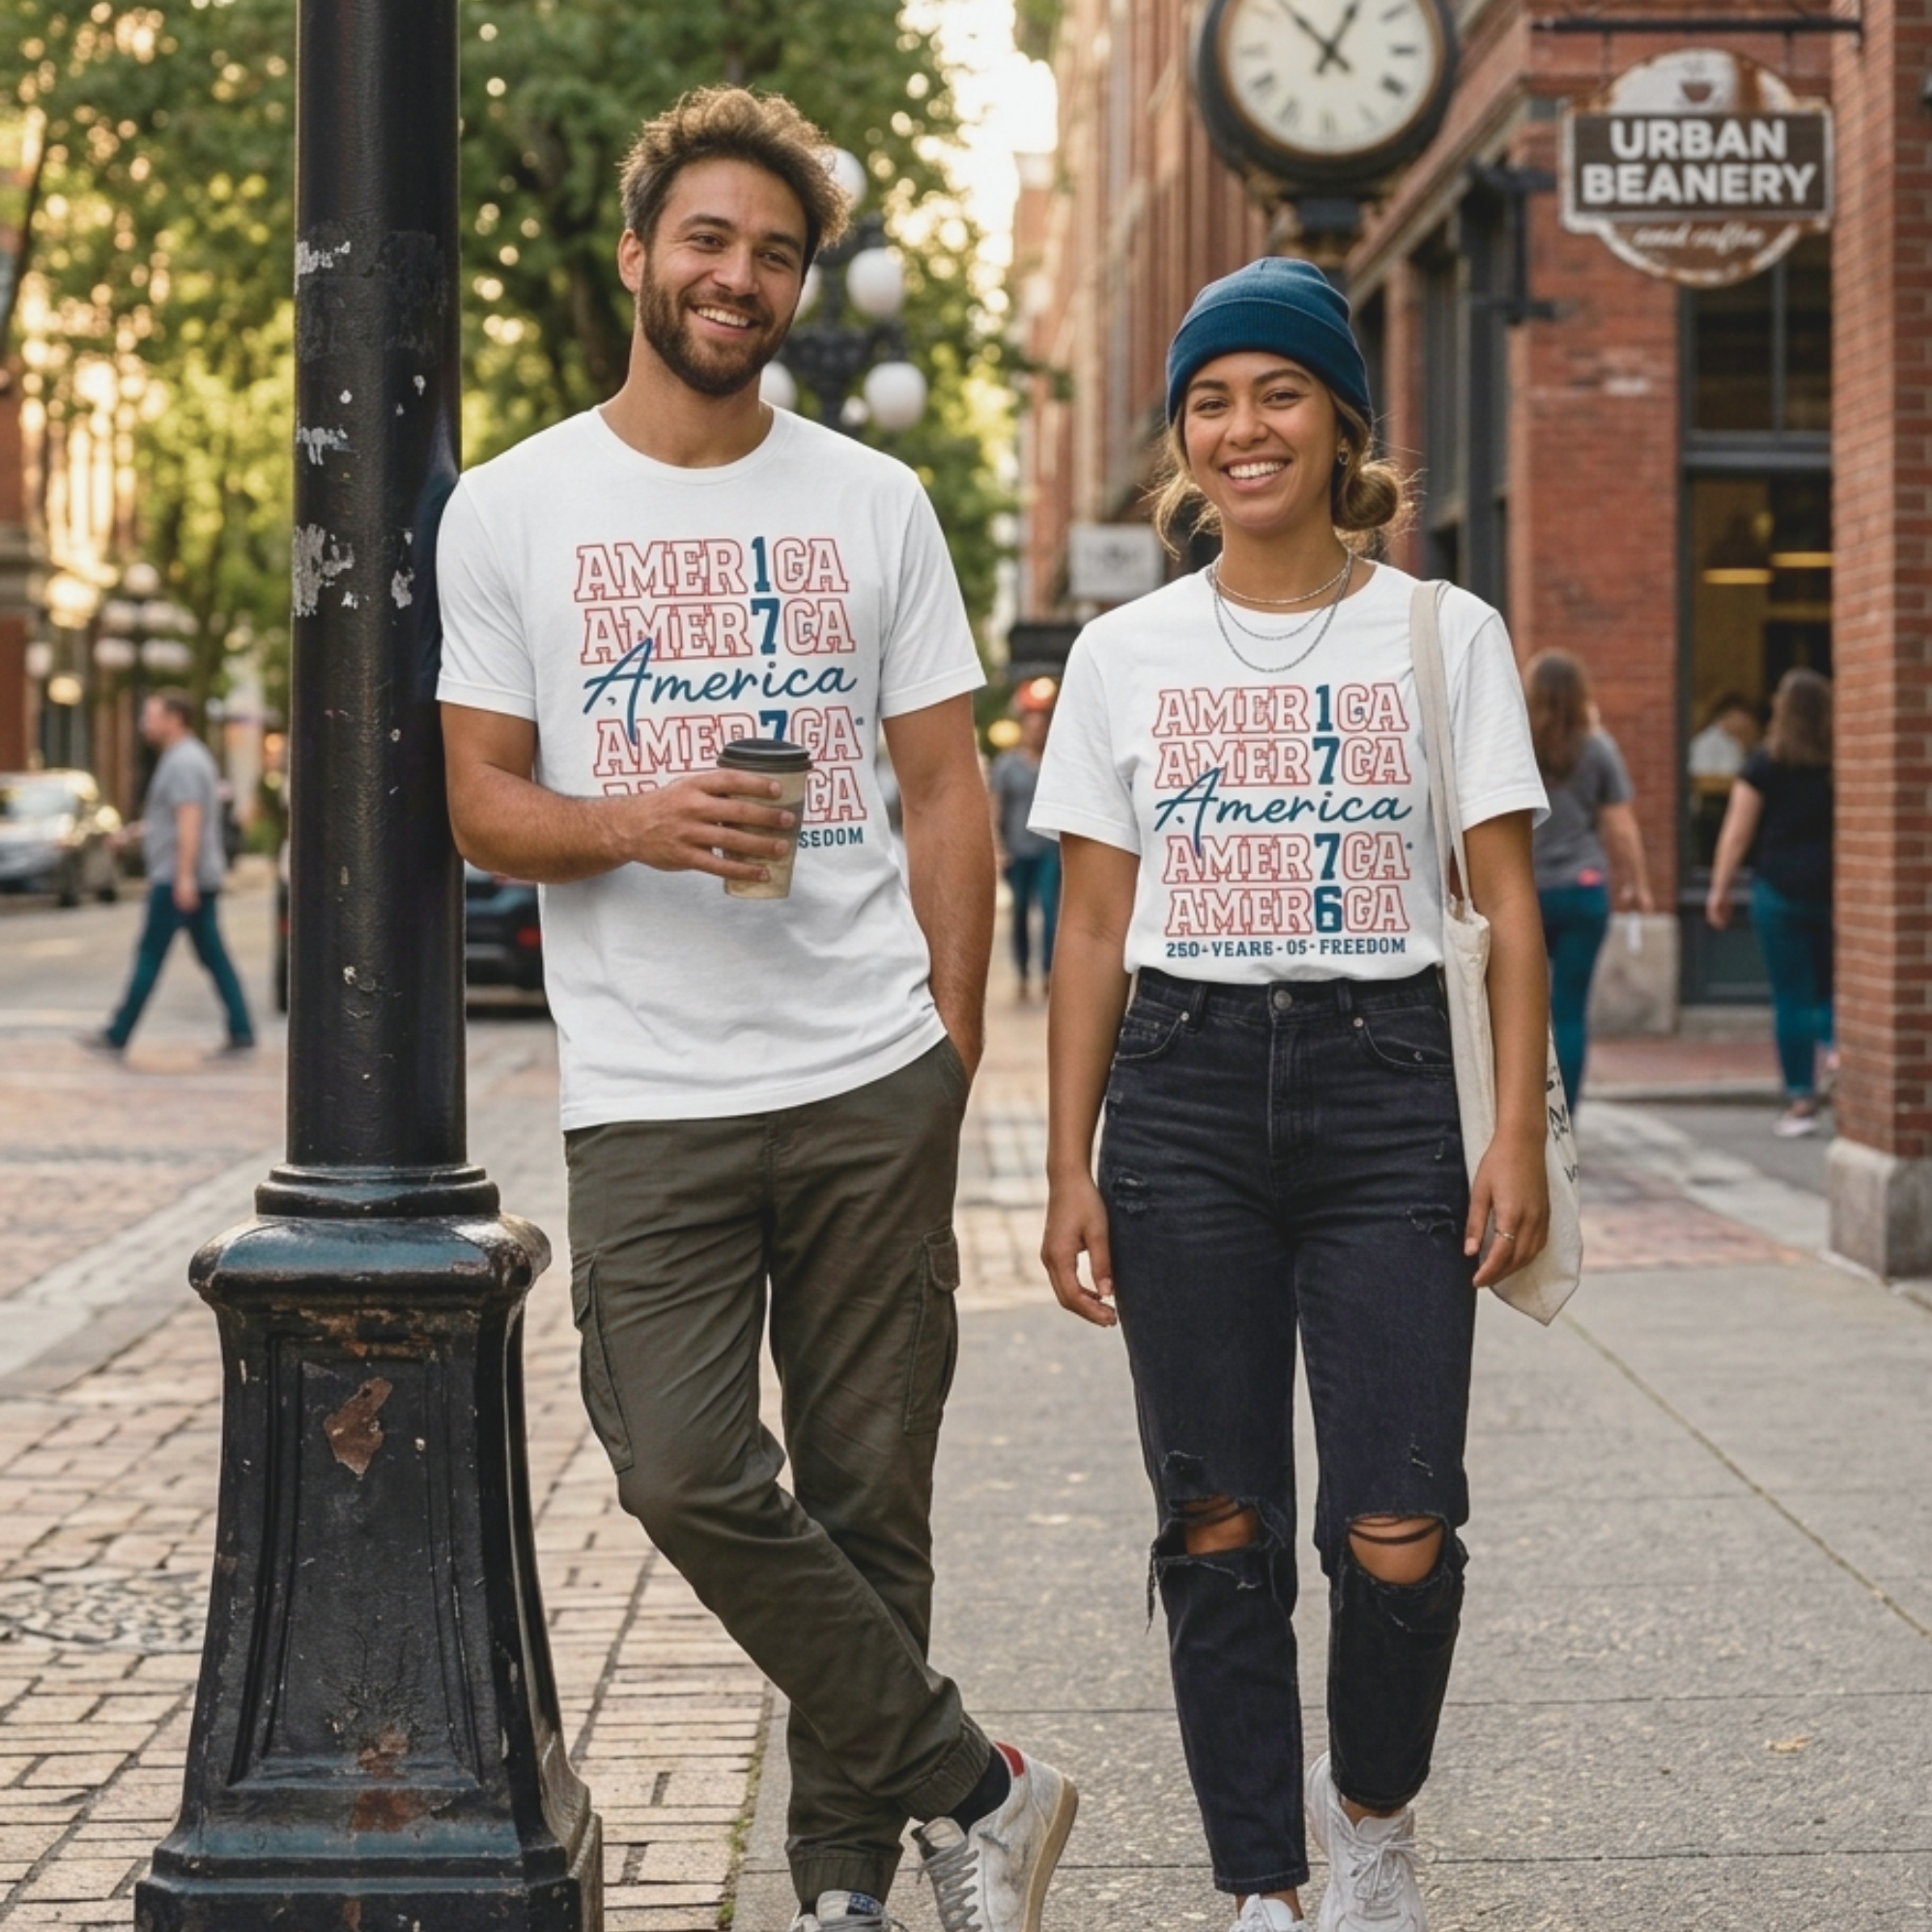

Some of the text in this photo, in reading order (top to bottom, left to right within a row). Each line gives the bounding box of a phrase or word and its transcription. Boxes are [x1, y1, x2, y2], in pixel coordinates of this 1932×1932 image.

[1610, 119, 1786, 160] URBAN
[1581, 163, 1817, 205] BEANERY
[582, 638, 858, 746] America
[1154, 767, 1412, 858] America
